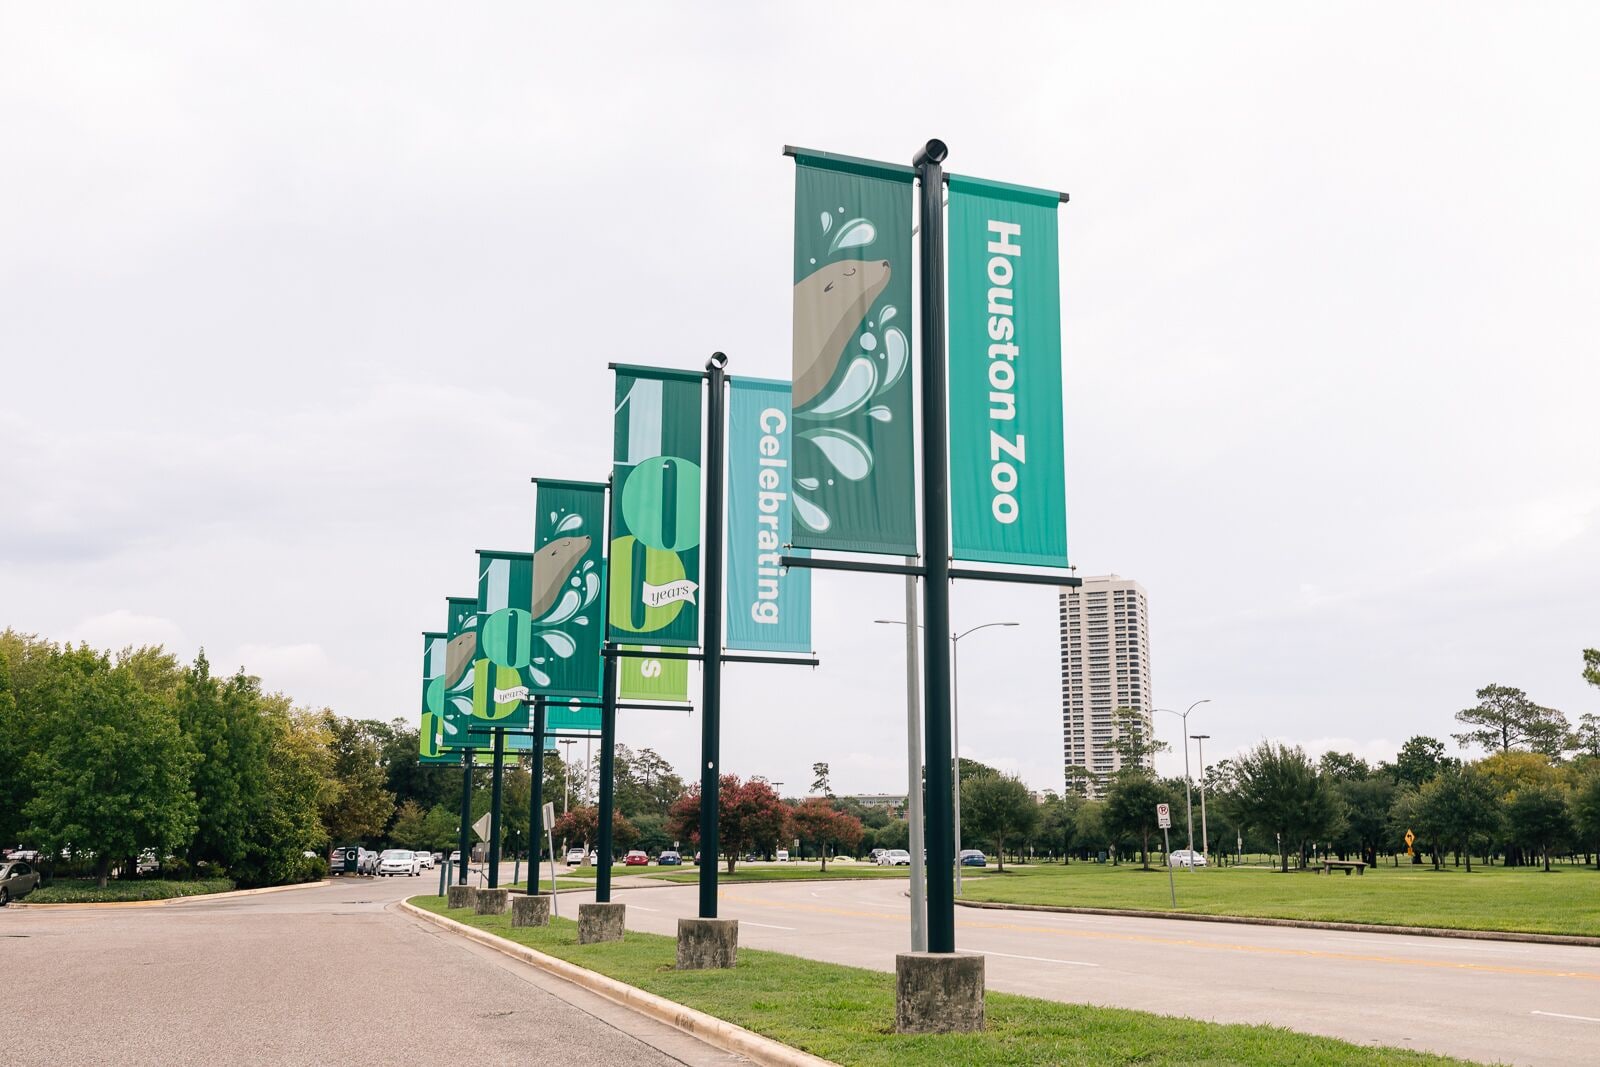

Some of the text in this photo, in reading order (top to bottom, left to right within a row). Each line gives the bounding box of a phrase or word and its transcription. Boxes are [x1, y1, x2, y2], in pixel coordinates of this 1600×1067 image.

[987, 219, 1026, 524] Houston Zoo
[651, 585, 689, 605] years
[751, 407, 788, 625] Celebrating
